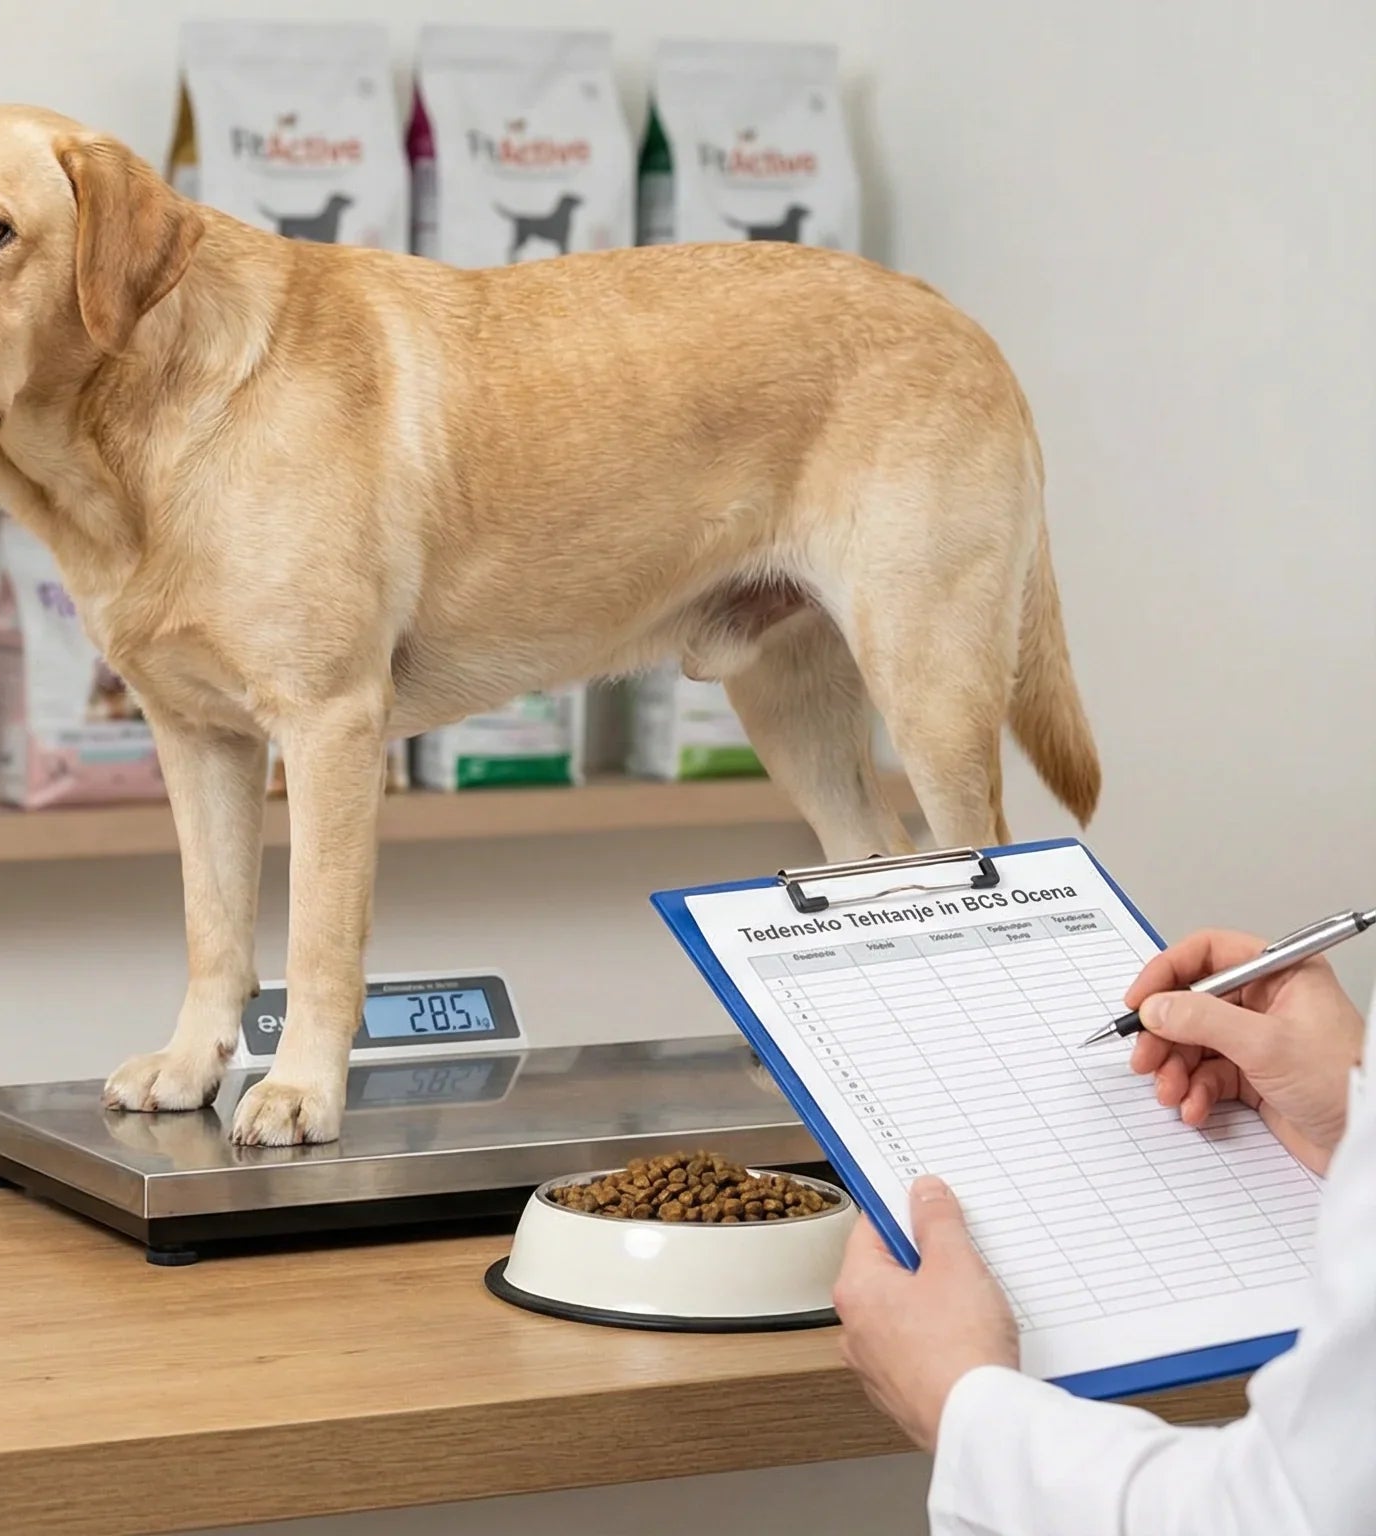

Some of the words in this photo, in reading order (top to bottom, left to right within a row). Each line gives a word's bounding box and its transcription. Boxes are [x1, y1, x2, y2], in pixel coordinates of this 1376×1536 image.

[738, 917, 842, 944] Tedensko
[843, 902, 934, 930] Tehtanje
[938, 895, 960, 916] in
[961, 888, 1009, 912] BCS
[1012, 884, 1077, 905] Ocena
[406, 993, 473, 1032] 28.5
